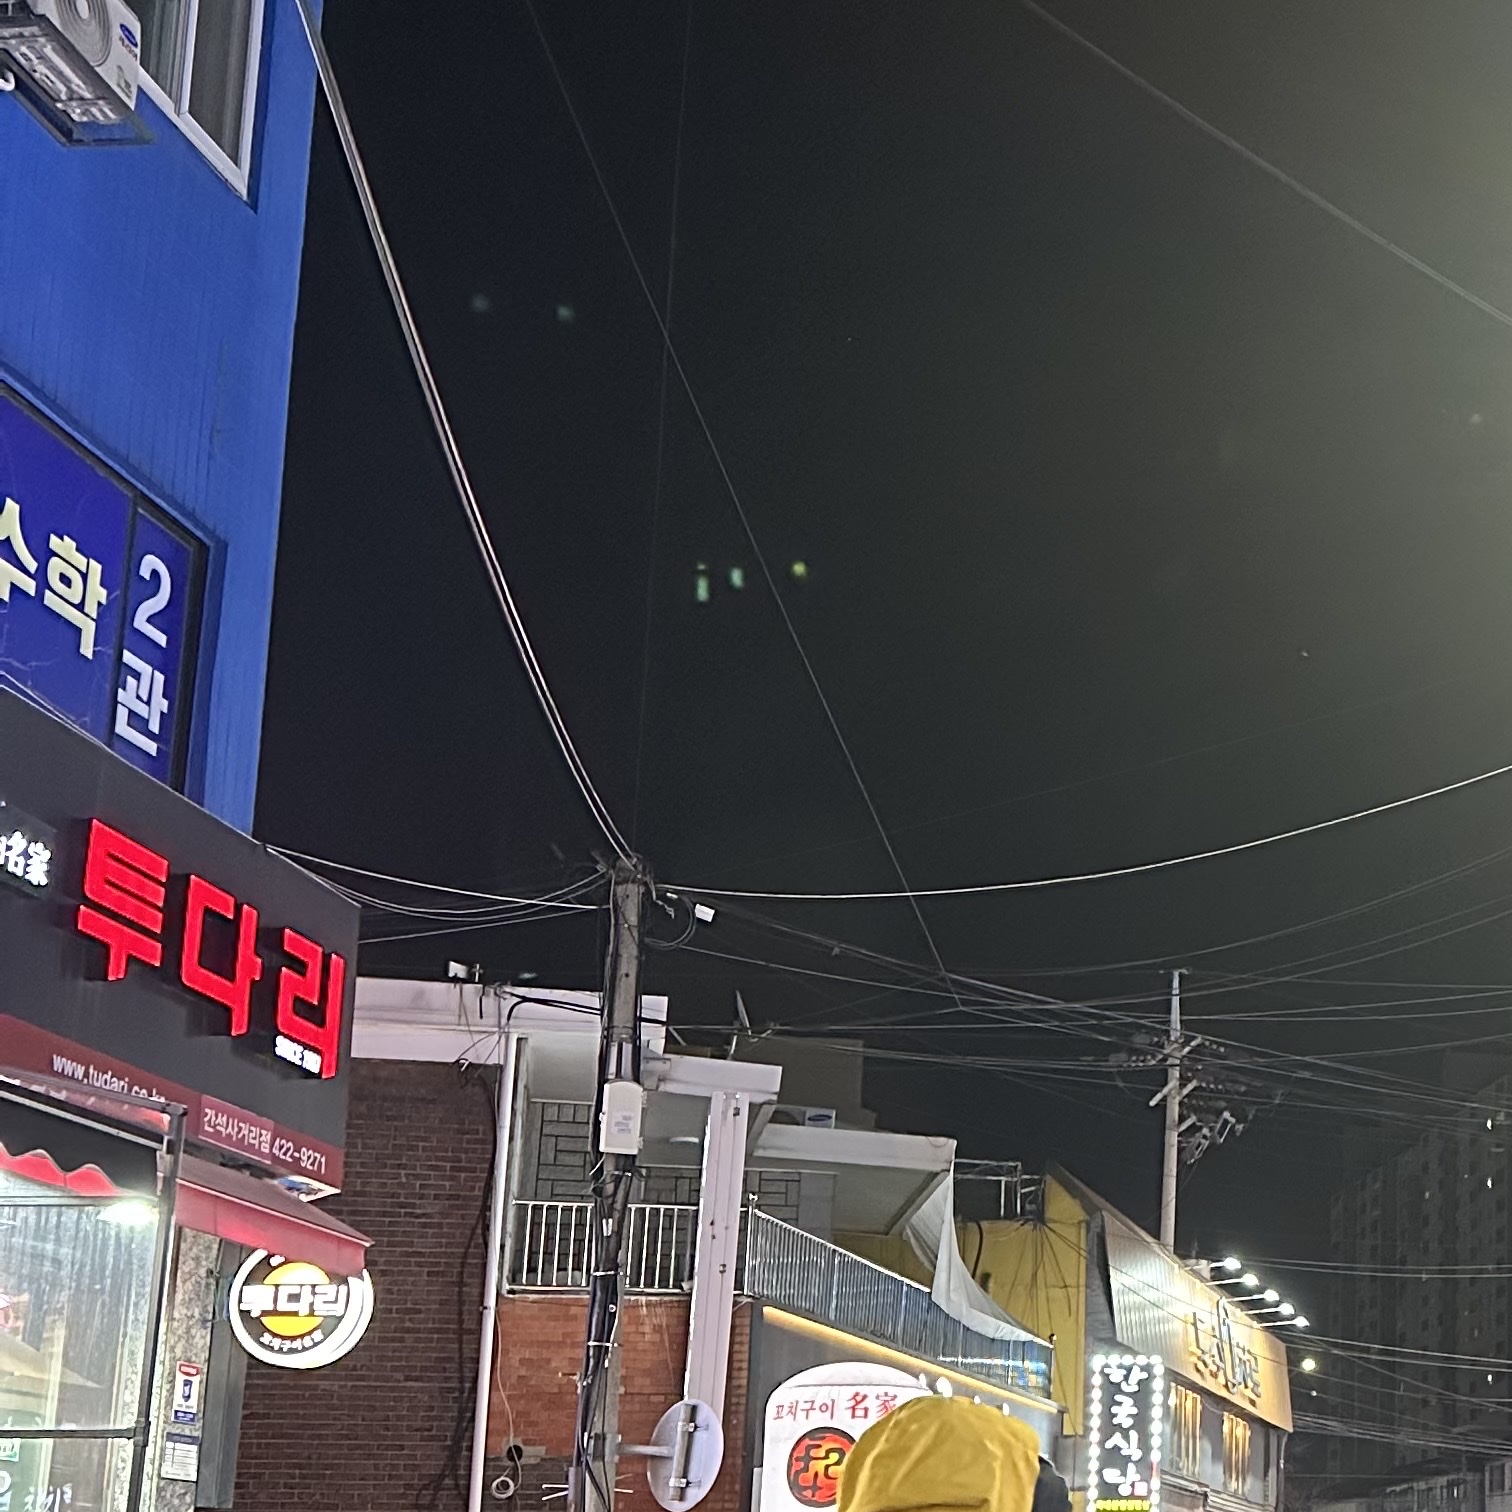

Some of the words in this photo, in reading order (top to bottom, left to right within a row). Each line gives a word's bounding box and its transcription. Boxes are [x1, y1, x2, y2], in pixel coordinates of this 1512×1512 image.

[77, 818, 346, 1080] 투다리
[204, 1108, 271, 1153] 간석사거리점
[273, 1138, 326, 1174] 422-9271
[240, 1284, 348, 1317] 투다리
[773, 1400, 836, 1420] 꼬치구이
[844, 1391, 897, 1419] 名家
[1102, 1365, 1149, 1497] 한국식당
